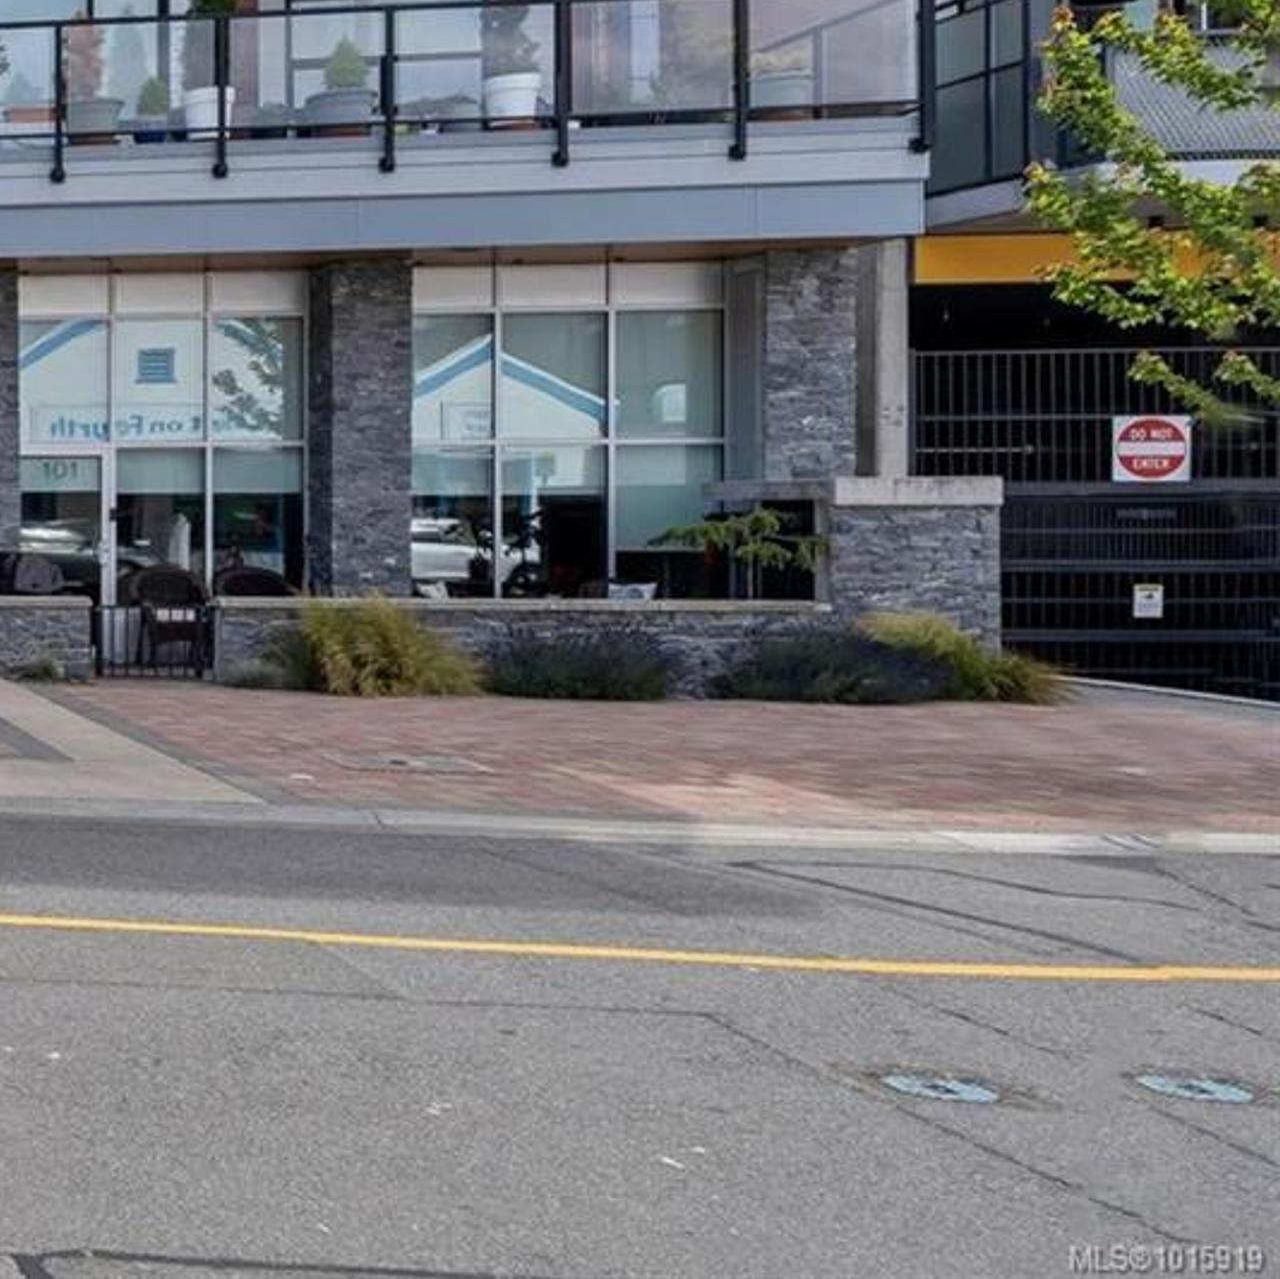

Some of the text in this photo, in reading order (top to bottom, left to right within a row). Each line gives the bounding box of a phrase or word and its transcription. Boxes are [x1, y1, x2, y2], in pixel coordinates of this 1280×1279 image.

[1130, 427, 1174, 440] DO NOT
[43, 461, 79, 479] 101
[1132, 457, 1170, 470] ENTER
